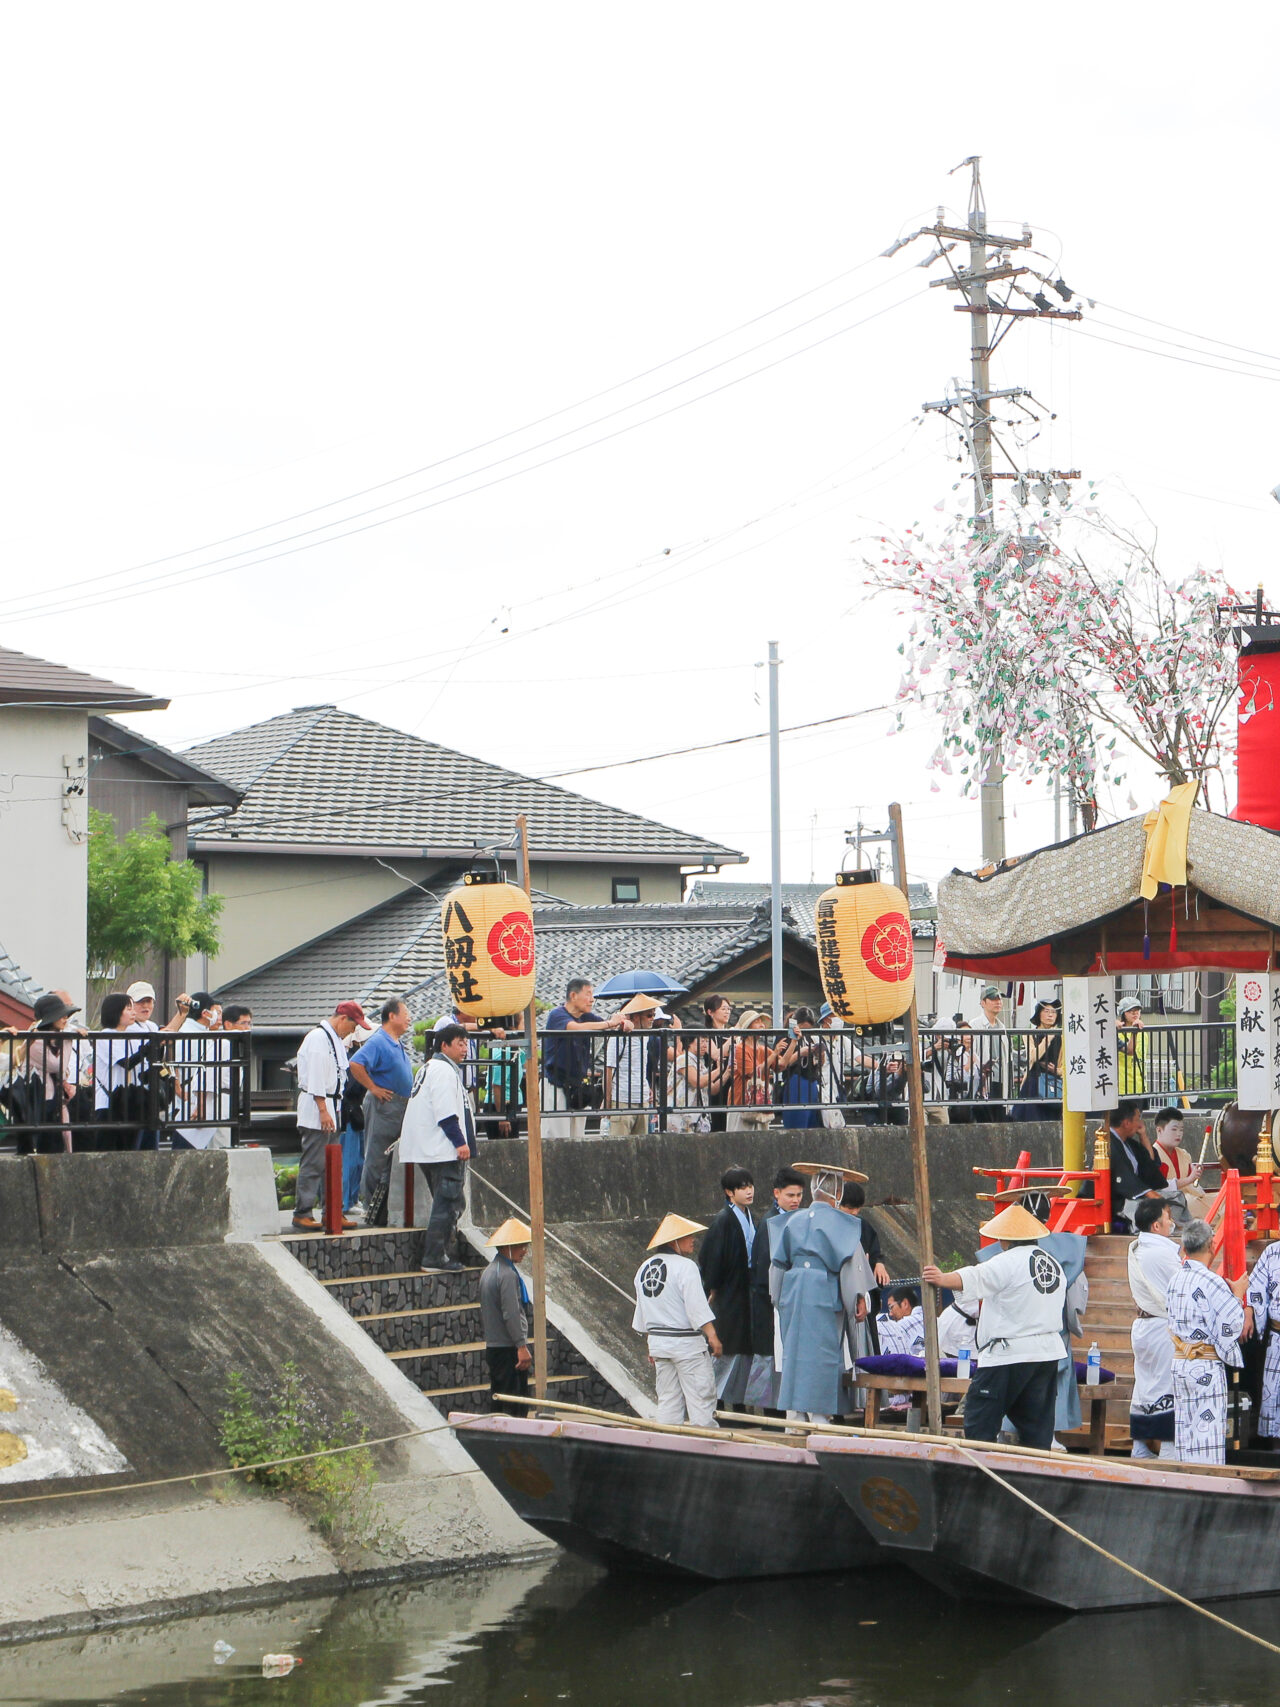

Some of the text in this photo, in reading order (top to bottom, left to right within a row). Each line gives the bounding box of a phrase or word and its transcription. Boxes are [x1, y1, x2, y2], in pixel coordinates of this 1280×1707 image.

[1068, 1013, 1087, 1075] 献燈
[1093, 993, 1113, 1096] 天下泰平
[1240, 1006, 1266, 1069] 献燈
